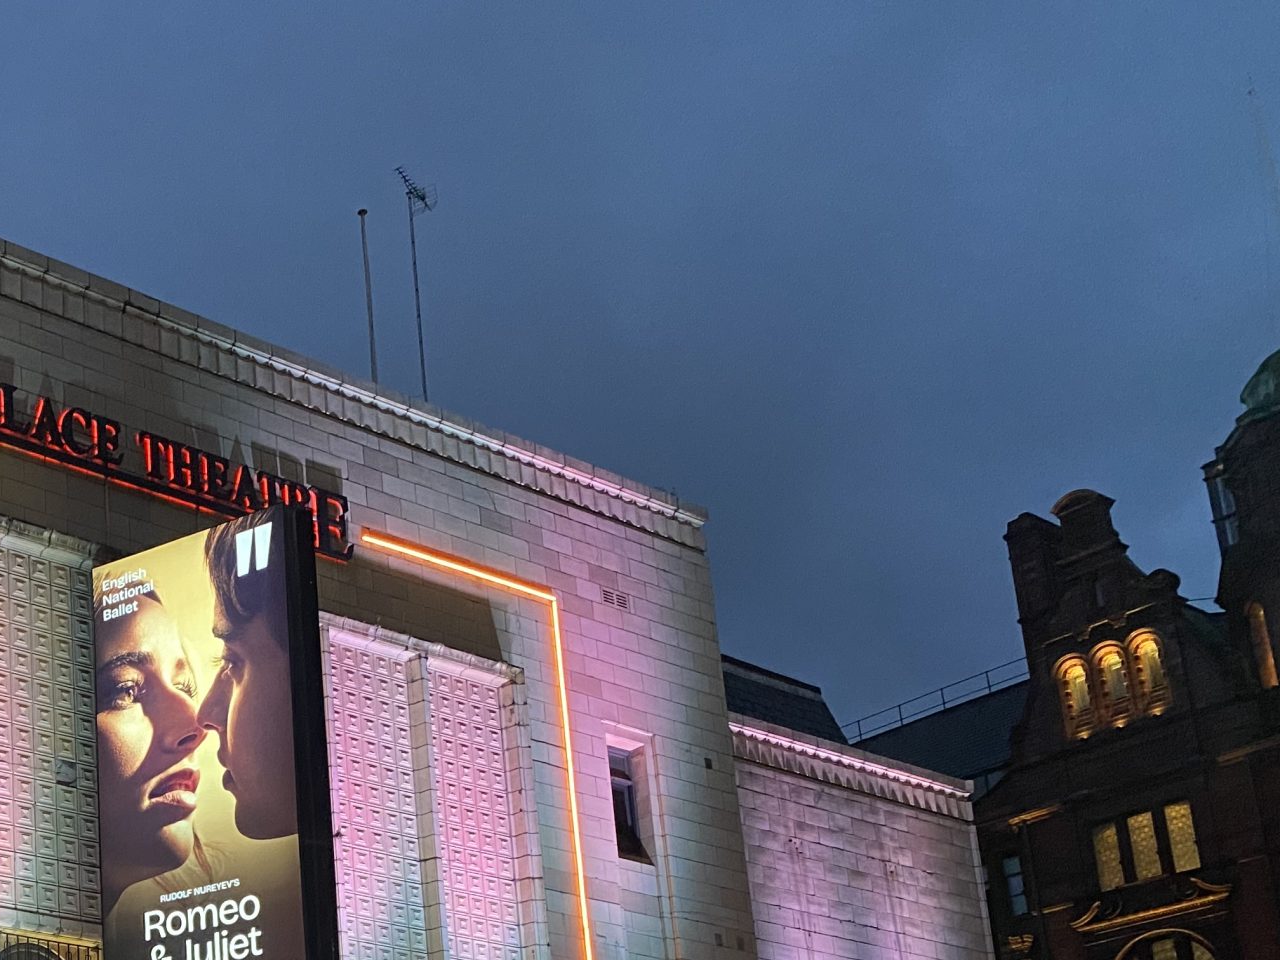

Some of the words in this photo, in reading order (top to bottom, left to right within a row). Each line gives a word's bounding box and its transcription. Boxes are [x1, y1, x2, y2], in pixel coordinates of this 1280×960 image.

[102, 567, 147, 593] English
[103, 580, 154, 607] National
[103, 600, 139, 621] Ballet
[160, 889, 192, 903] RUDOLF
[143, 894, 261, 942] Romeo
